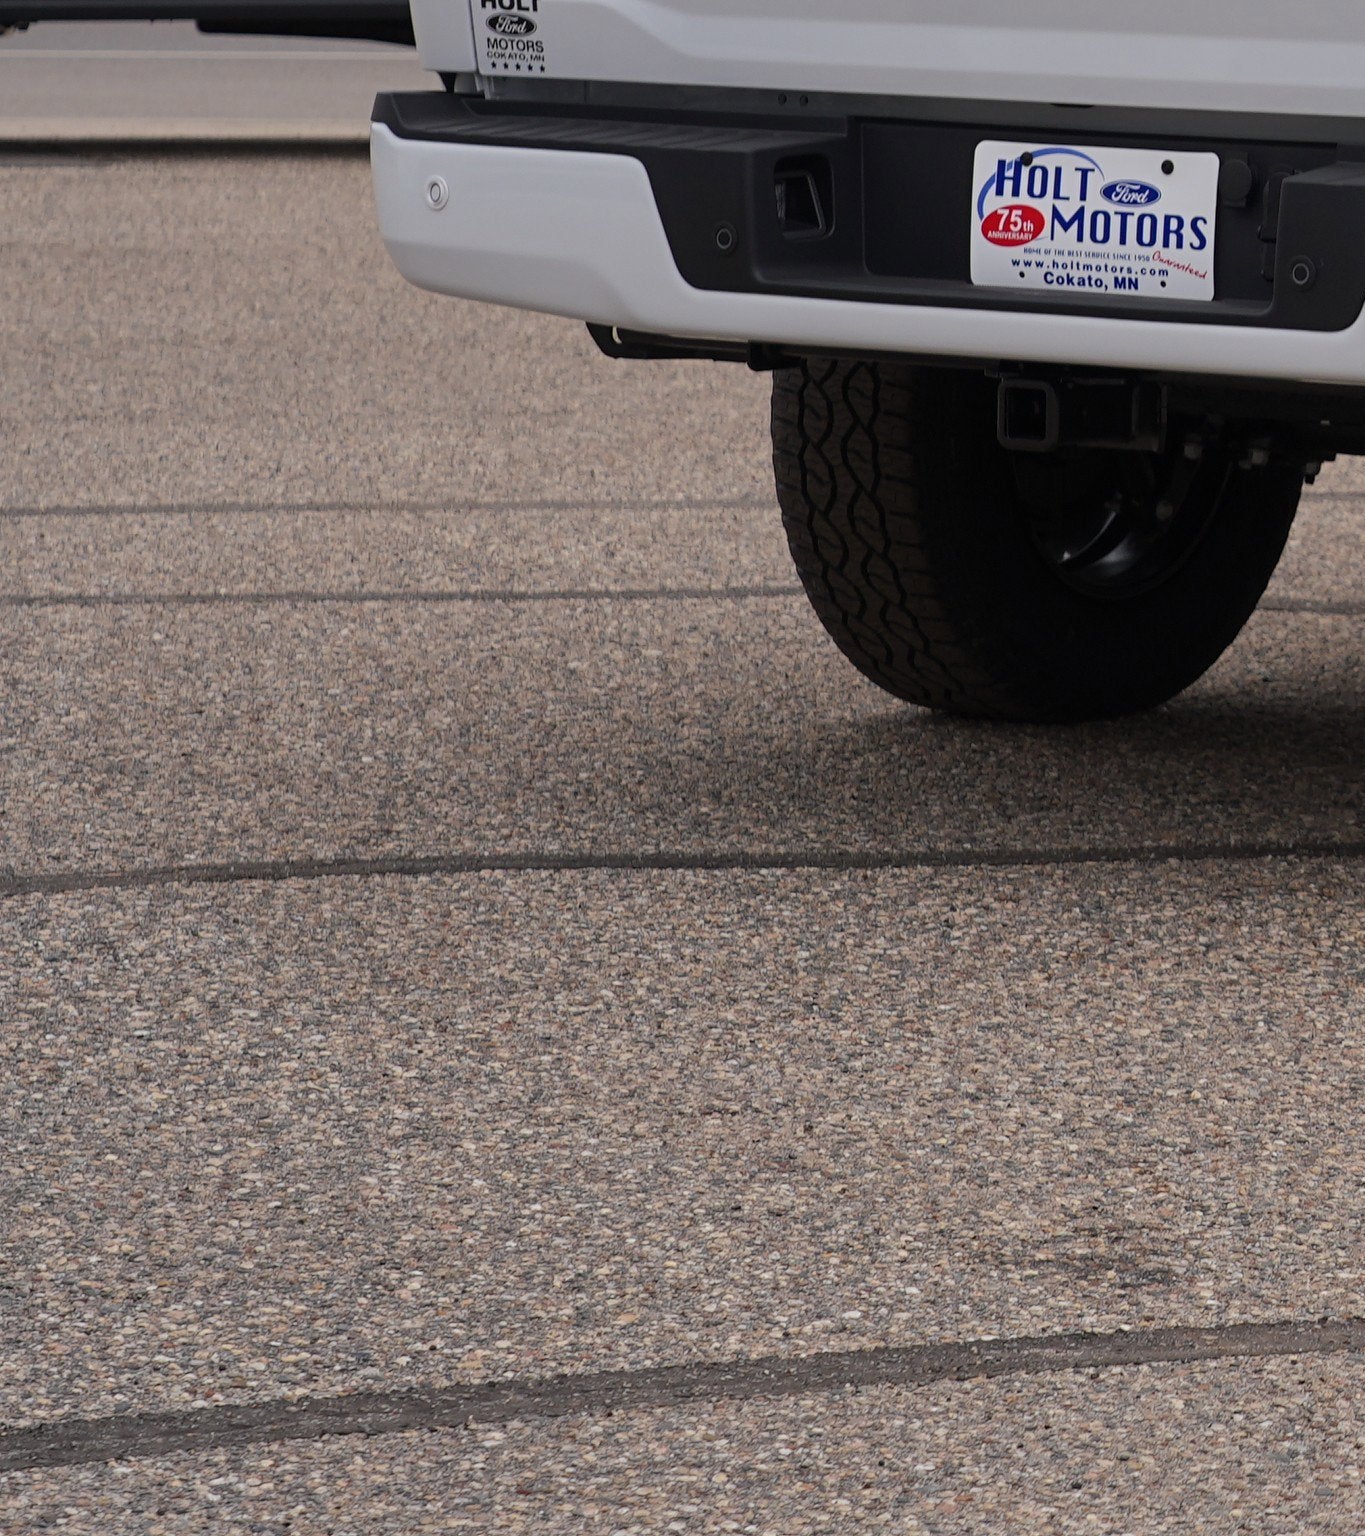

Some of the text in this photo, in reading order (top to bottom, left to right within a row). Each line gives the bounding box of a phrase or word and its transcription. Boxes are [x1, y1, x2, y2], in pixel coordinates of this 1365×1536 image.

[496, 15, 527, 34] Ford
[487, 37, 544, 53] MOTORS
[487, 51, 545, 62] COKATO, MN
[995, 158, 1095, 201] HOLT
[1111, 182, 1149, 205] Ford
[997, 208, 1034, 232] 75th
[1050, 203, 1208, 251] MOTORS
[987, 230, 1033, 241] ANNIVERSARY
[1023, 247, 1042, 255] HOME
[1044, 248, 1053, 256] OF
[1054, 249, 1066, 257] THE
[1067, 250, 1083, 258] BEST
[1084, 250, 1110, 260] SERVICE
[1112, 253, 1131, 261] SINCE
[1011, 257, 1170, 277] www.holtmotors.com
[1043, 271, 1139, 291] Cokato, MN
